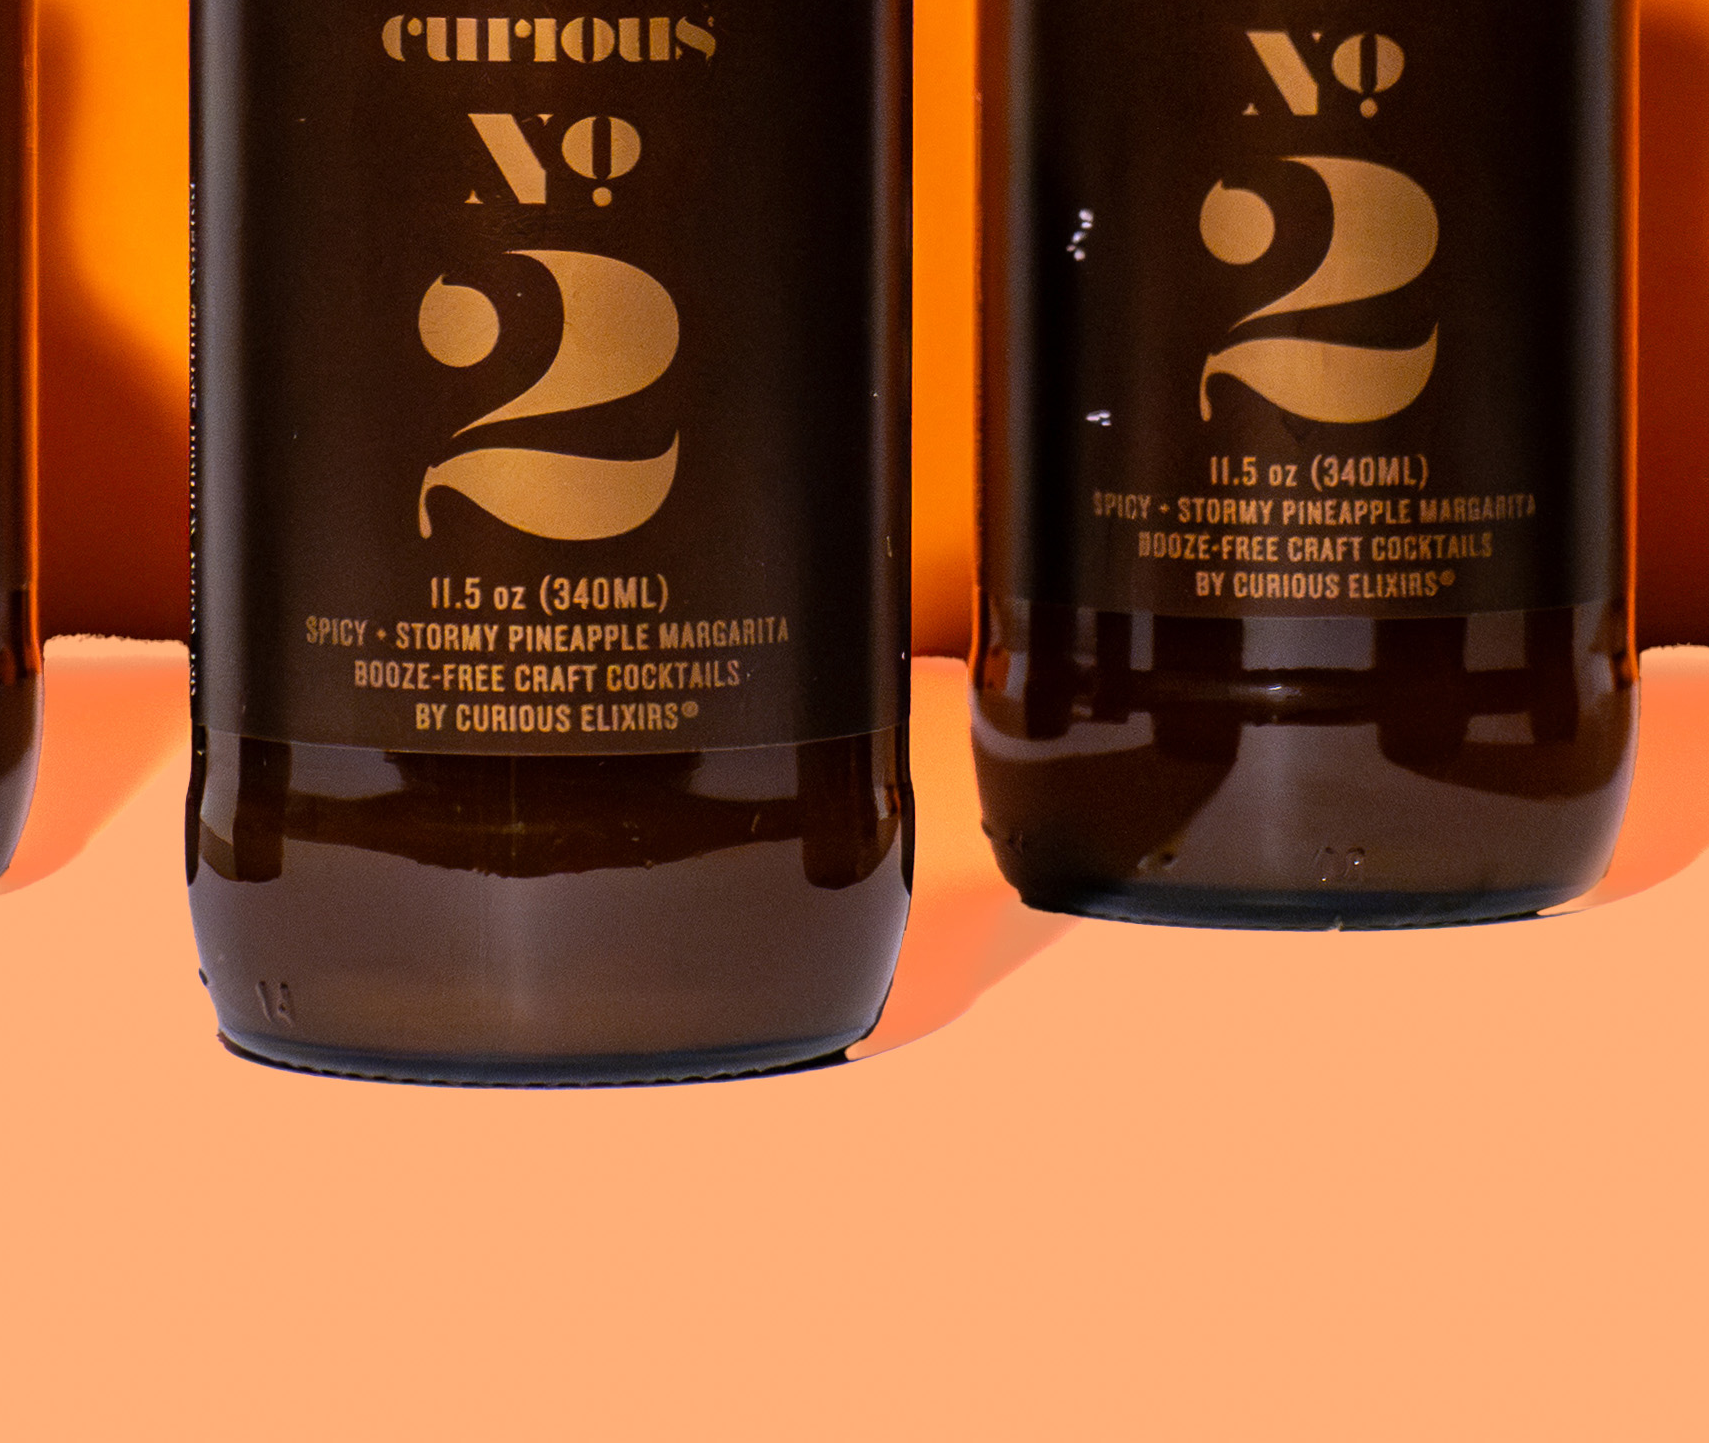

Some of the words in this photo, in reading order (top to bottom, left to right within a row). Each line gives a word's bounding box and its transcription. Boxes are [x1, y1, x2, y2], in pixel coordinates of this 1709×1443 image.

[381, 11, 718, 64] curious
[1199, 154, 1438, 424] 2
[417, 248, 680, 541] 2
[1210, 455, 1258, 487] 11.5
[1268, 463, 1298, 488] oz
[1310, 453, 1429, 491] (340ML)
[1094, 491, 1151, 520] SPICY
[1178, 497, 1273, 525] STORMY
[1282, 499, 1410, 525] PINEAPPLE
[1420, 494, 1535, 522] MARGARITA
[1139, 531, 1278, 561] BOOZE-FREE
[1288, 537, 1362, 562] CRAFT
[1372, 532, 1493, 561] COCKTAILS
[430, 576, 482, 610] 11.5
[493, 585, 526, 611] oz
[539, 573, 669, 615] (340ML)
[1196, 571, 1224, 597] BY
[1234, 572, 1339, 599] CURIOUS
[306, 615, 367, 647] SPICY
[396, 622, 499, 653] STORMY
[508, 623, 649, 653] PINEAPPLE
[659, 616, 788, 650] MARGARITA
[355, 660, 504, 692] BOOZE-FREE
[515, 665, 597, 693] CRAFT
[607, 660, 740, 692] COCKTAILS
[416, 703, 446, 731] BY
[456, 704, 570, 733] CURIOUS
